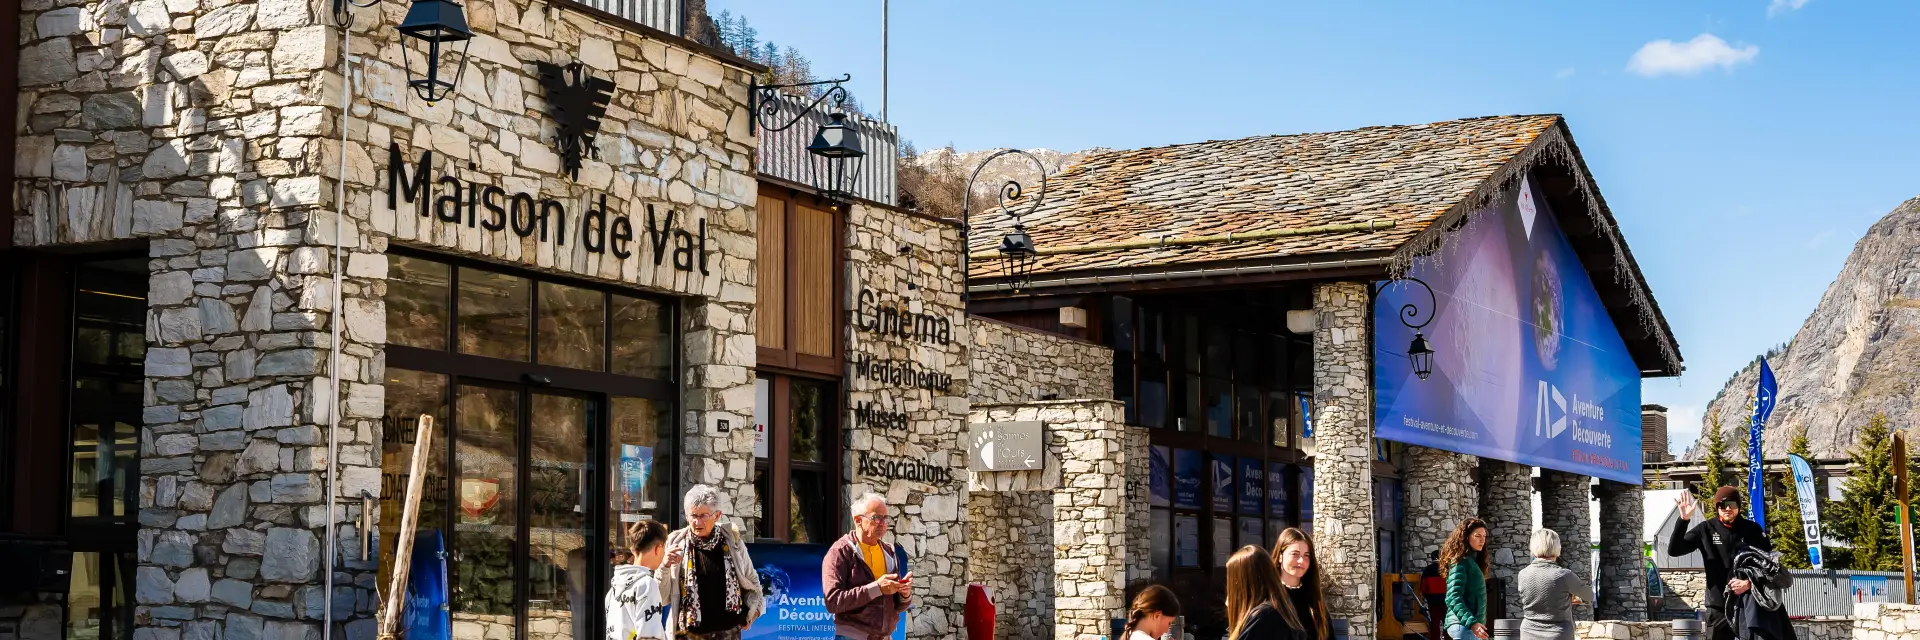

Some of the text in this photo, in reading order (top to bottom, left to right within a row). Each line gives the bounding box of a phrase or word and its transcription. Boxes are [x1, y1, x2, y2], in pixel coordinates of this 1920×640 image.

[388, 142, 710, 277] Maison de Val
[858, 288, 951, 347] Cinéma
[1572, 393, 1604, 421] Aventure
[1572, 420, 1612, 449] Découverte
[858, 451, 953, 484] Associations
[778, 624, 811, 632] FESTIVAL
